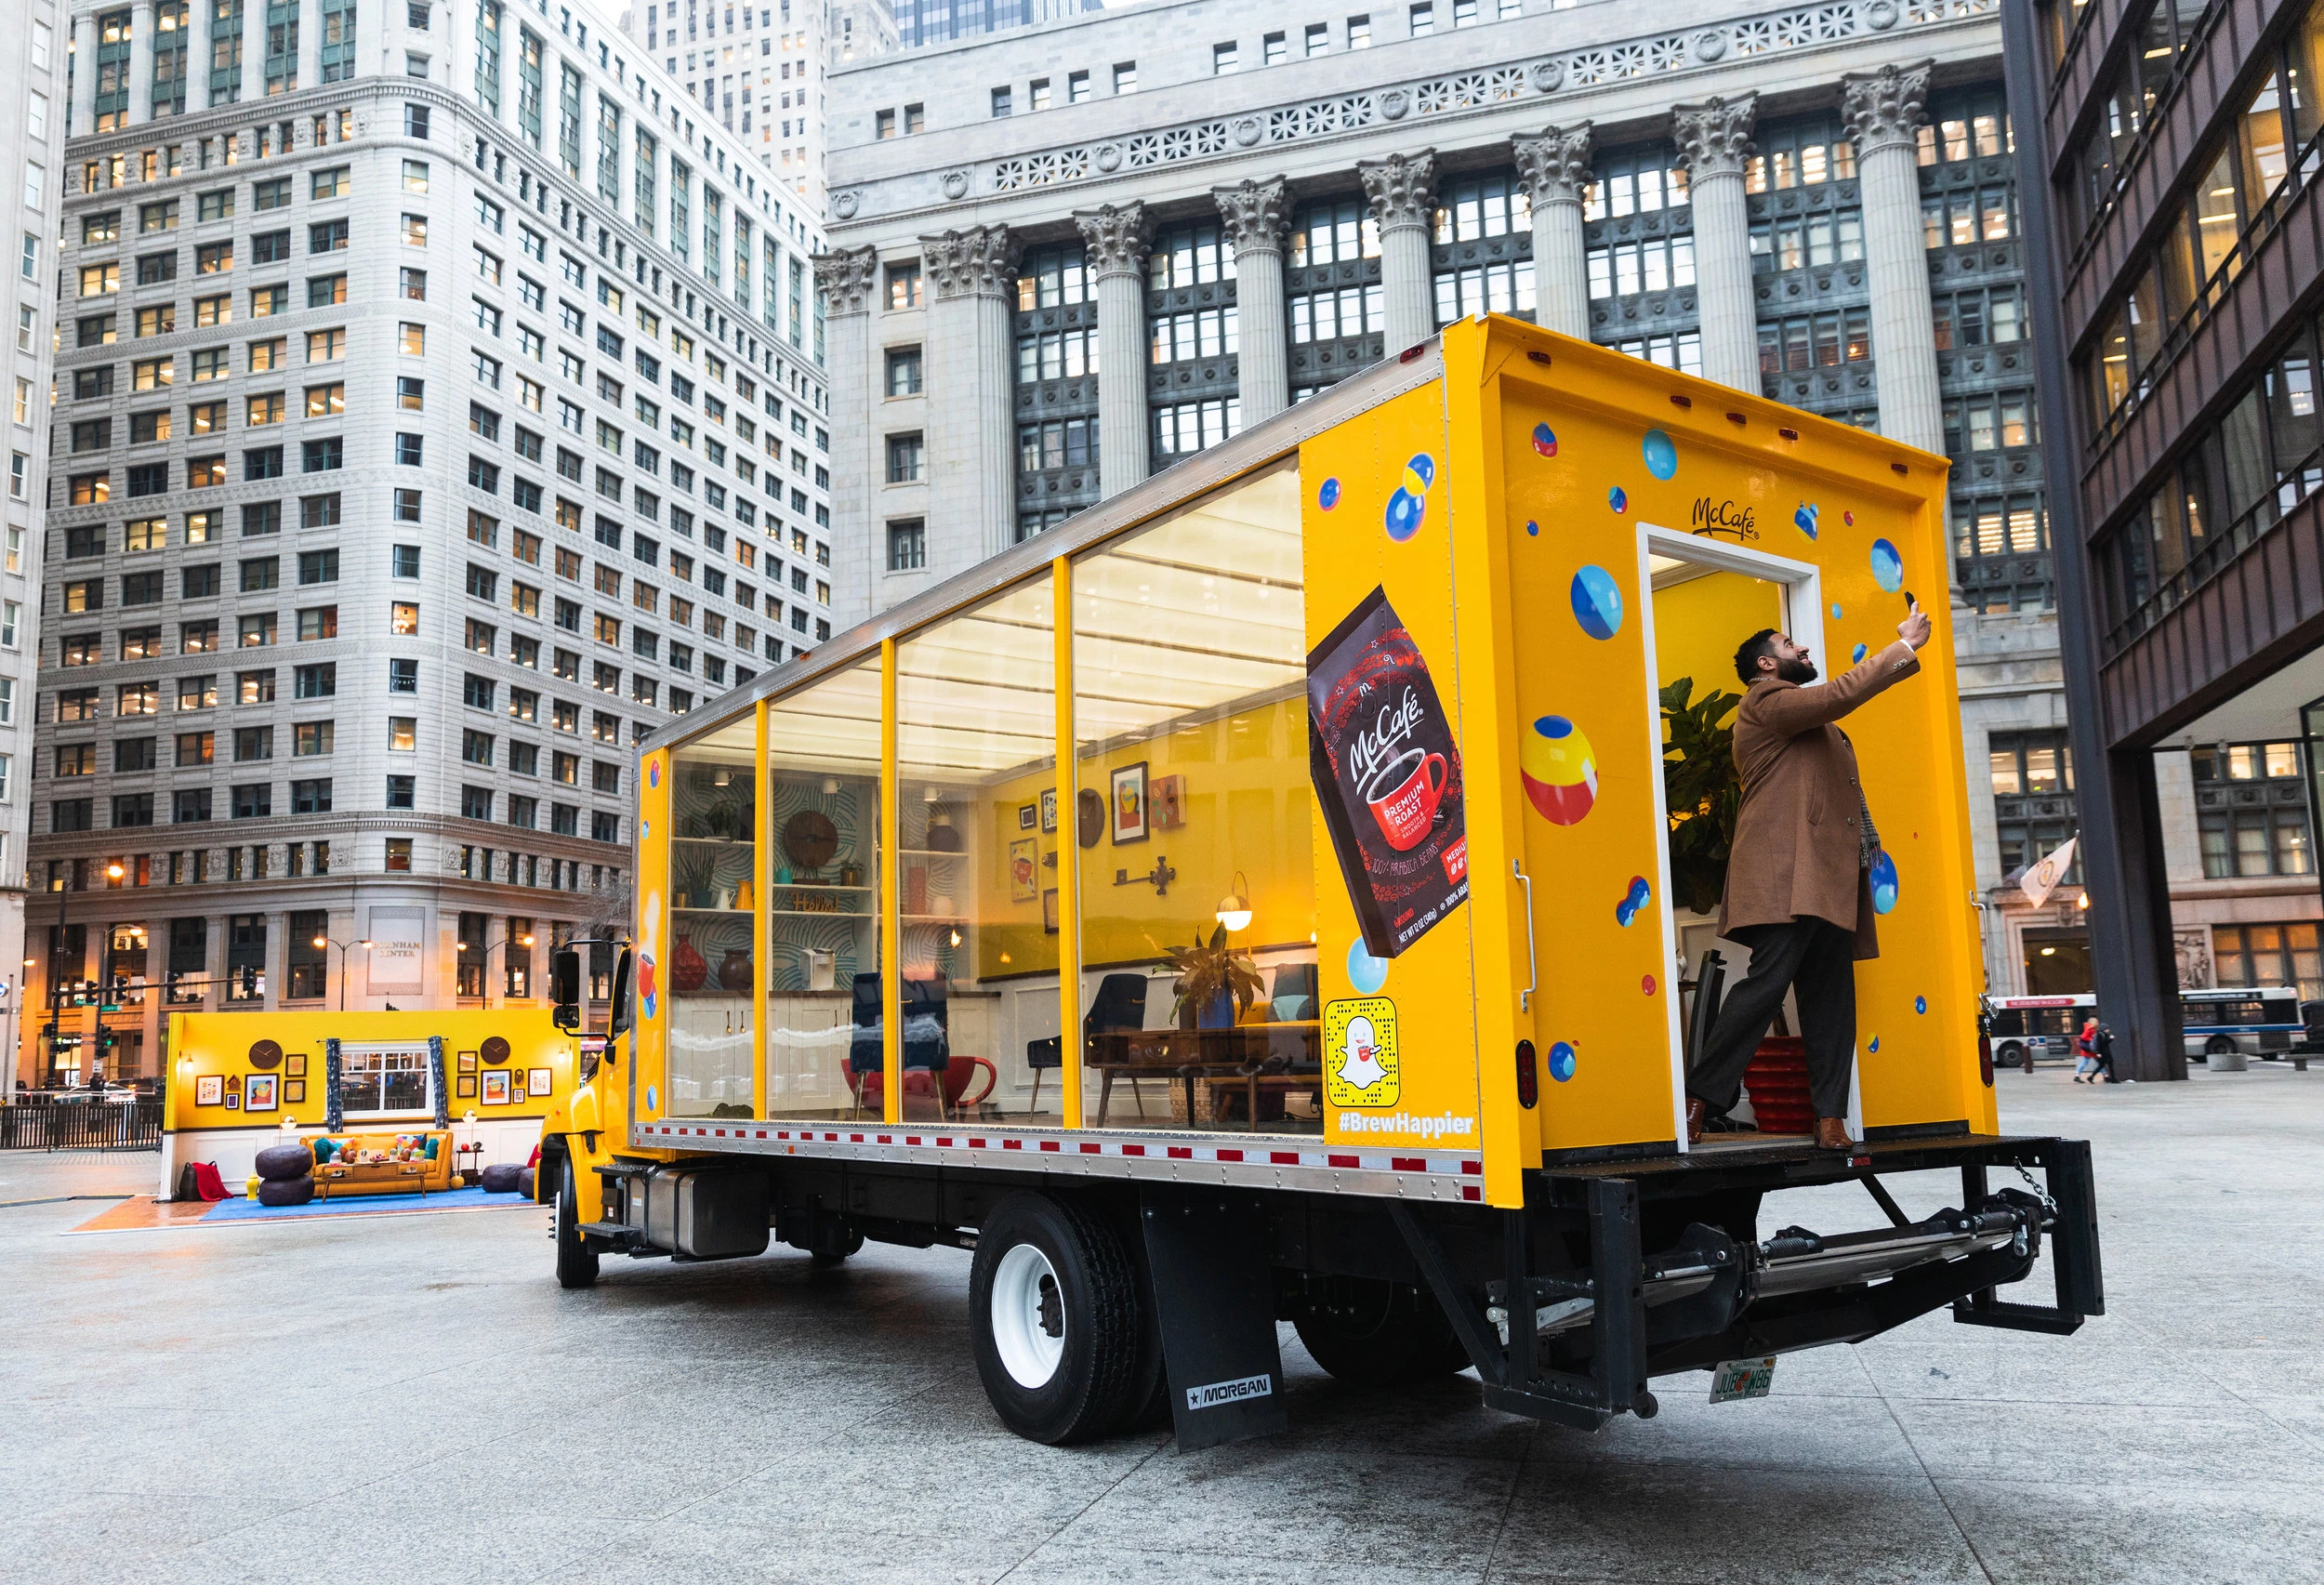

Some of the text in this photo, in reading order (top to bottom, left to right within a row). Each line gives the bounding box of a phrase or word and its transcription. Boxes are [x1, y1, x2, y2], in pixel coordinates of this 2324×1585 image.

[1692, 497, 1755, 541] McCafé
[1350, 685, 1421, 784] McCafé
[1383, 780, 1425, 820] PREMIUM
[1394, 797, 1421, 826] ROAST
[1400, 815, 1420, 833] SMOOTH
[1402, 816, 1427, 839] BALANCED
[1389, 858, 1419, 876] ARABICA
[1419, 842, 1439, 866] BEANS
[1446, 840, 1467, 863] MEDIU
[1393, 907, 1415, 928] GROUND
[378, 949, 416, 958] CENTER
[1339, 1110, 1474, 1140] #BrewHappier
[1203, 1378, 1268, 1403] MORGAN
